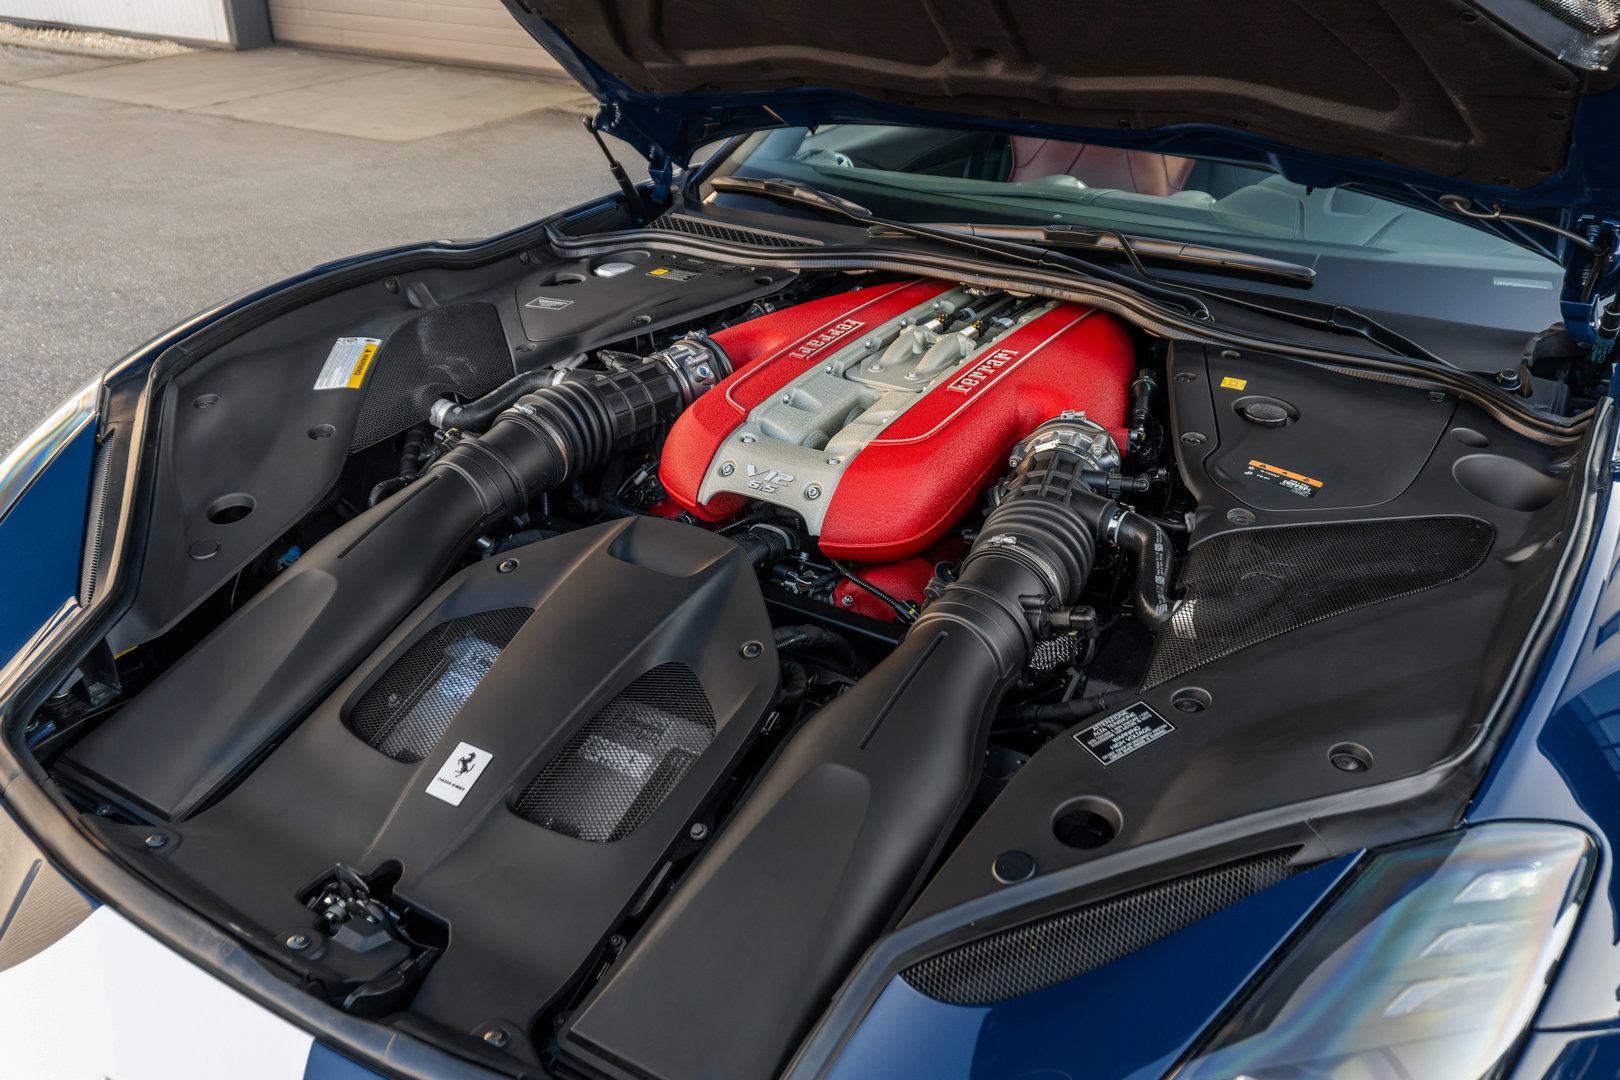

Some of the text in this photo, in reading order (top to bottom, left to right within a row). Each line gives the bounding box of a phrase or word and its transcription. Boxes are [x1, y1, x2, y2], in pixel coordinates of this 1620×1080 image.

[789, 318, 865, 360] Ferrari
[946, 349, 1020, 395] Ferrari
[747, 464, 795, 486] V12
[748, 479, 779, 494] 6.5
[1092, 710, 1129, 731] ATTENZIONE
[1093, 727, 1107, 737] ALTA
[1109, 739, 1126, 750] HIGH
[1125, 726, 1152, 741] VOLTAGE
[1111, 726, 1141, 742] WARNING
